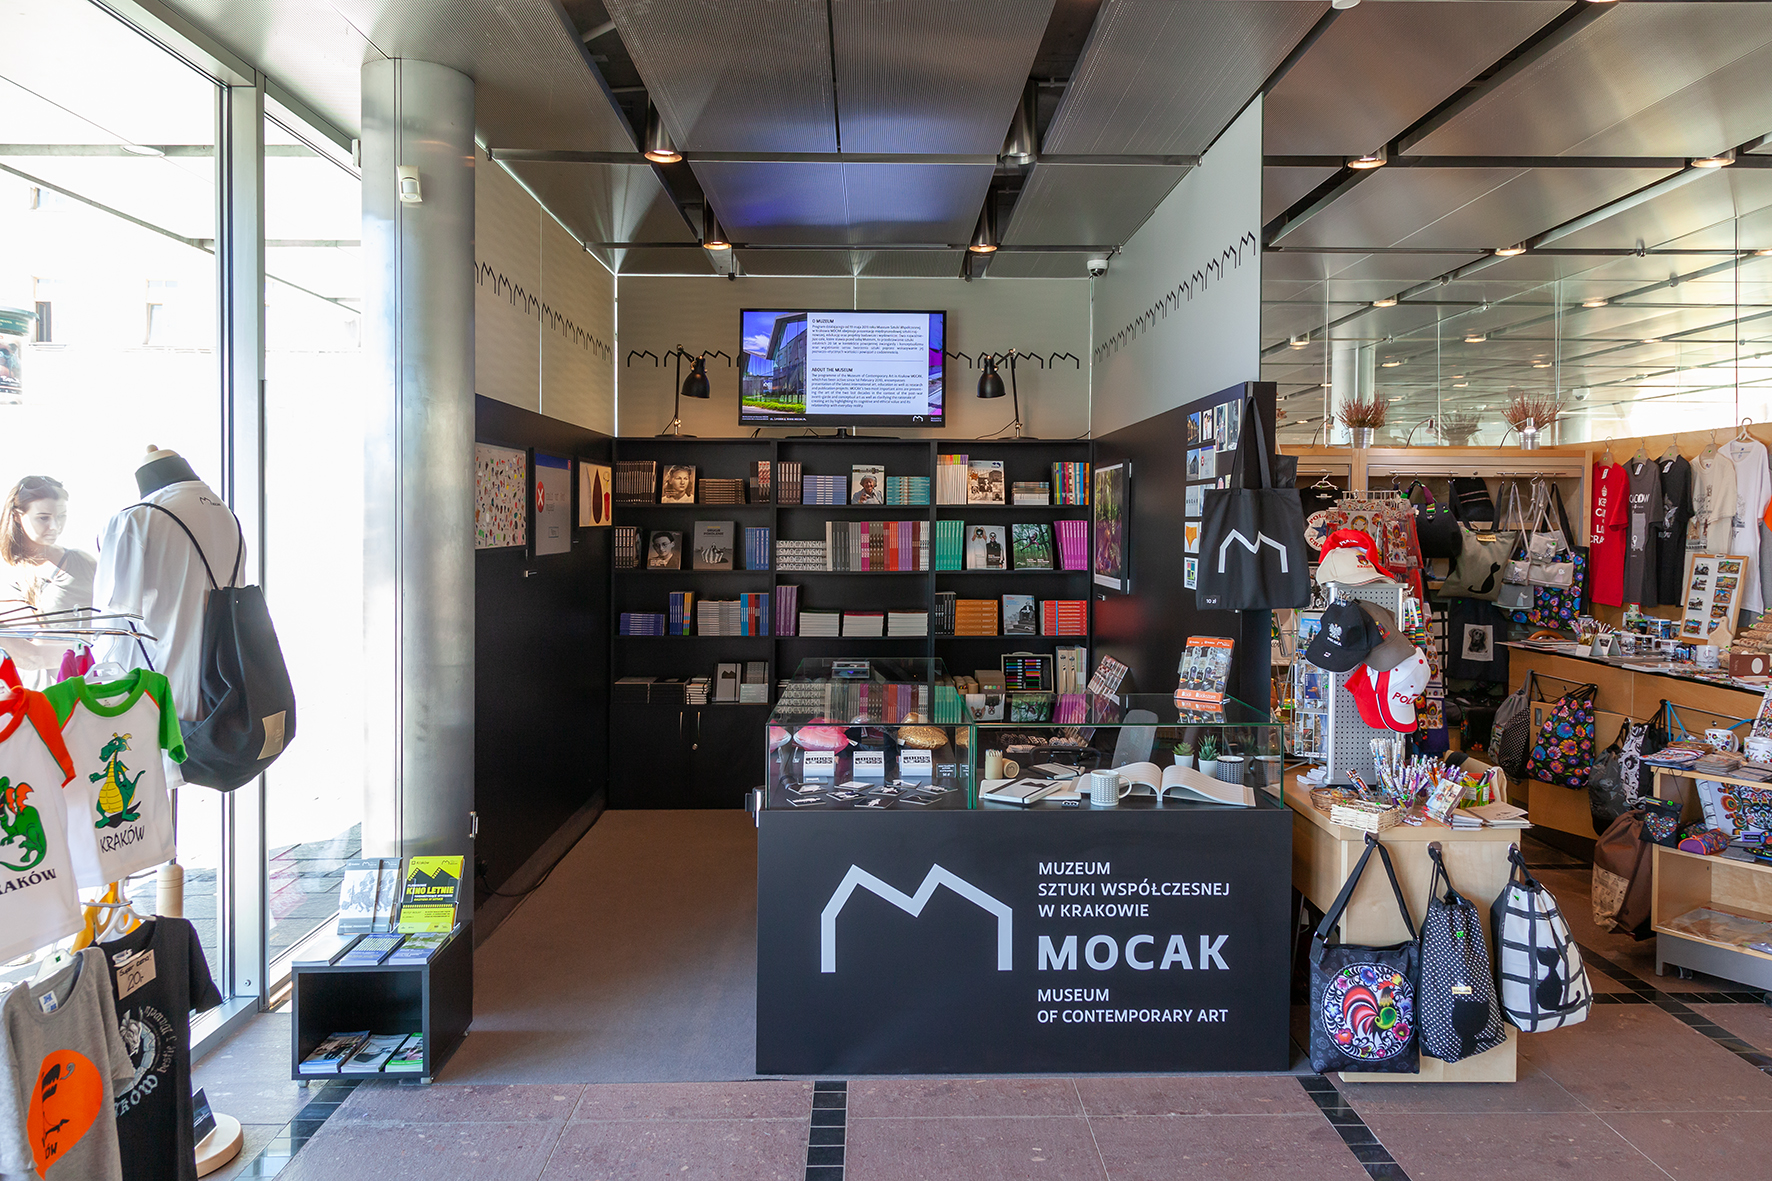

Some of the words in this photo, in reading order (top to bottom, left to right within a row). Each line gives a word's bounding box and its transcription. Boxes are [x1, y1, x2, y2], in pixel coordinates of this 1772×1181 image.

[100, 825, 145, 853] KRAKÓW
[1038, 862, 1110, 874] MUZEUM
[0, 868, 56, 895] AKÓW
[1038, 883, 1094, 896] SZTUKI
[1100, 878, 1230, 896] WSPÓŁCZESNEJ
[1038, 904, 1055, 917] W
[1060, 904, 1149, 917] KRAKOWIE
[1038, 934, 1230, 970] MOCAK
[120, 965, 134, 977] Super
[1038, 988, 1108, 1002] MUSEUM
[1038, 1010, 1058, 1022] OF
[1062, 1010, 1192, 1022] CONTEMPORARY
[1196, 1010, 1228, 1022] ART
